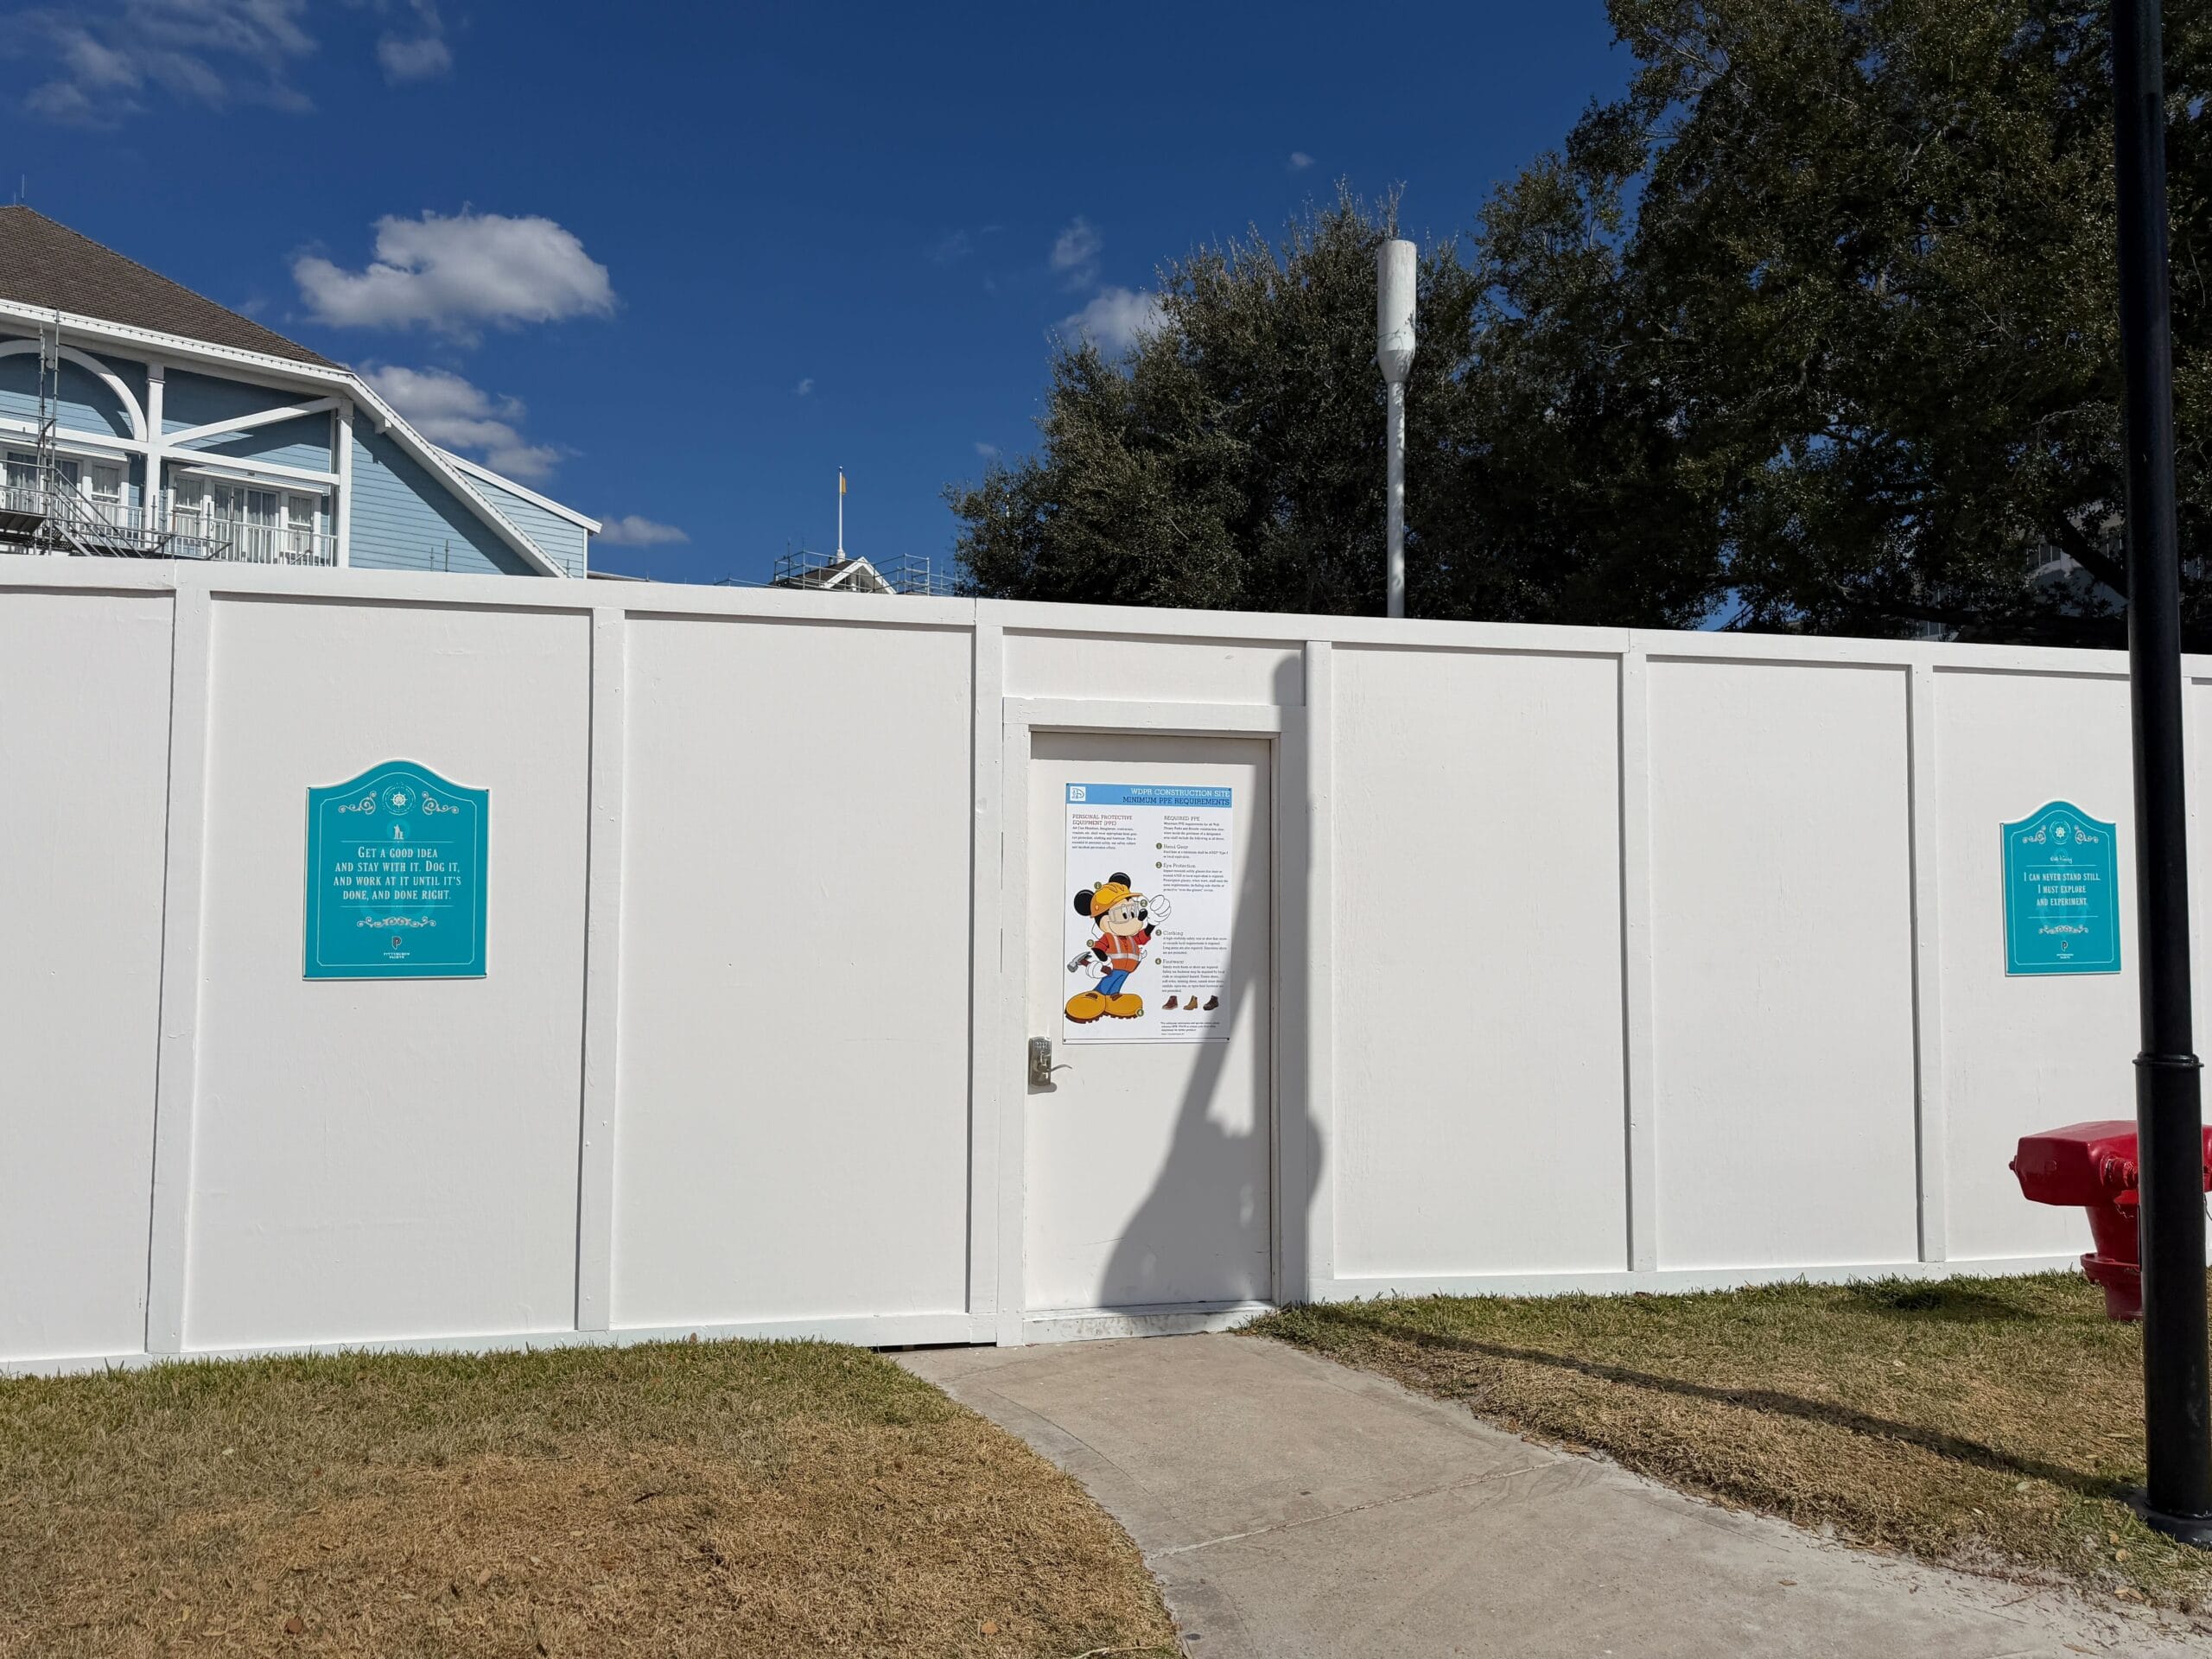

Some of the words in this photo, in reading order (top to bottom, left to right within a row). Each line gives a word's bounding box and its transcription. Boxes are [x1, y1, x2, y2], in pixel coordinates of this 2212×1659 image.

[1154, 788, 1212, 798] CONSTRUCTION
[1122, 796, 1157, 804] MINIMUM
[1174, 798, 1230, 806] REQUIREMENTS
[358, 846, 377, 858] GET
[379, 849, 386, 858] A
[389, 849, 414, 858] GOOD
[417, 849, 438, 858] IDEA
[334, 862, 353, 872] AND
[357, 862, 379, 872] STAY
[382, 862, 406, 872] WITH
[425, 861, 445, 872] DOG
[334, 876, 353, 886] AND
[355, 876, 381, 886] WORK
[385, 876, 397, 886] AT
[400, 876, 410, 886] IT
[413, 876, 440, 886] UNTIL
[372, 890, 391, 899] AND
[394, 890, 418, 899] DONE
